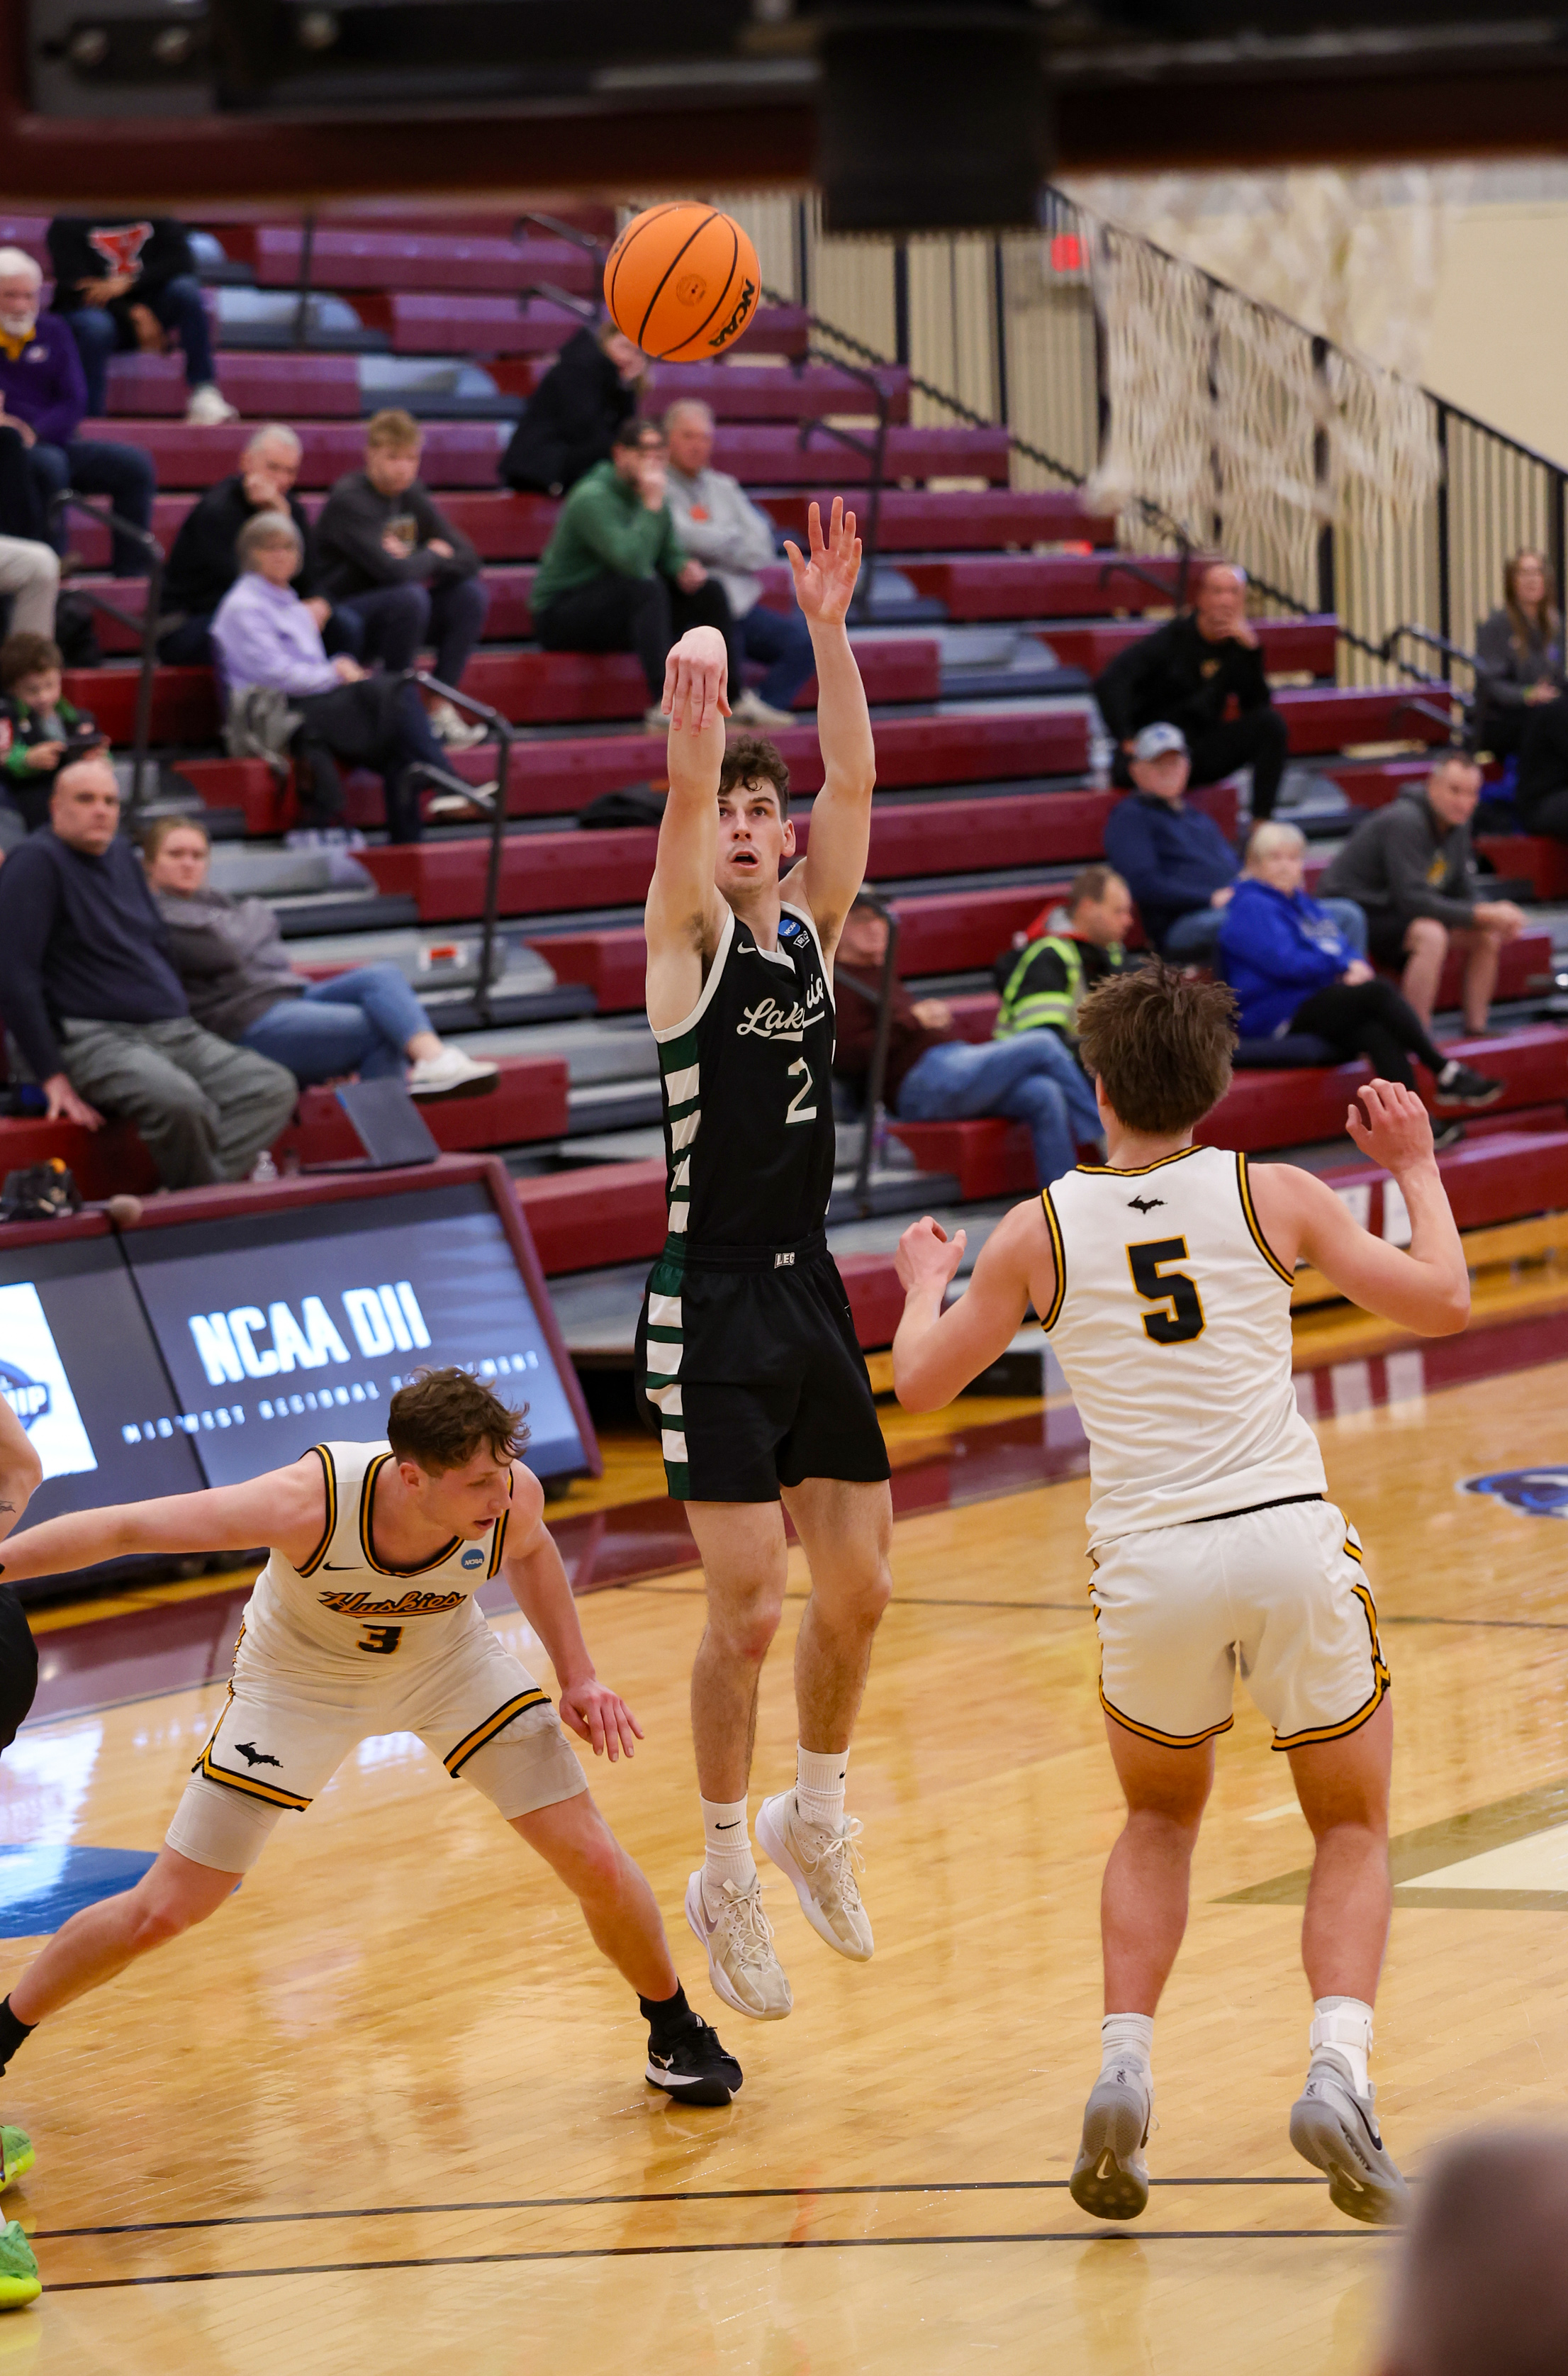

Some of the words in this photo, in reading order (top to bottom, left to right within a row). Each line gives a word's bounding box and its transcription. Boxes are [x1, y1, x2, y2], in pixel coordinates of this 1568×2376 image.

[709, 278, 755, 347] NCAA
[783, 921, 797, 935] NCAA
[785, 1056, 817, 1125] 2
[774, 1252, 795, 1269] LEC
[1124, 1234, 1207, 1347] 5
[188, 1295, 352, 1386] NCAA
[341, 1280, 432, 1359] DII
[121, 1404, 245, 1445] MIDWEST
[258, 1380, 381, 1420] REGIONAL
[464, 1558, 483, 1566] NCAA
[316, 1590, 468, 1619] Huskies
[355, 1623, 405, 1655] 3
